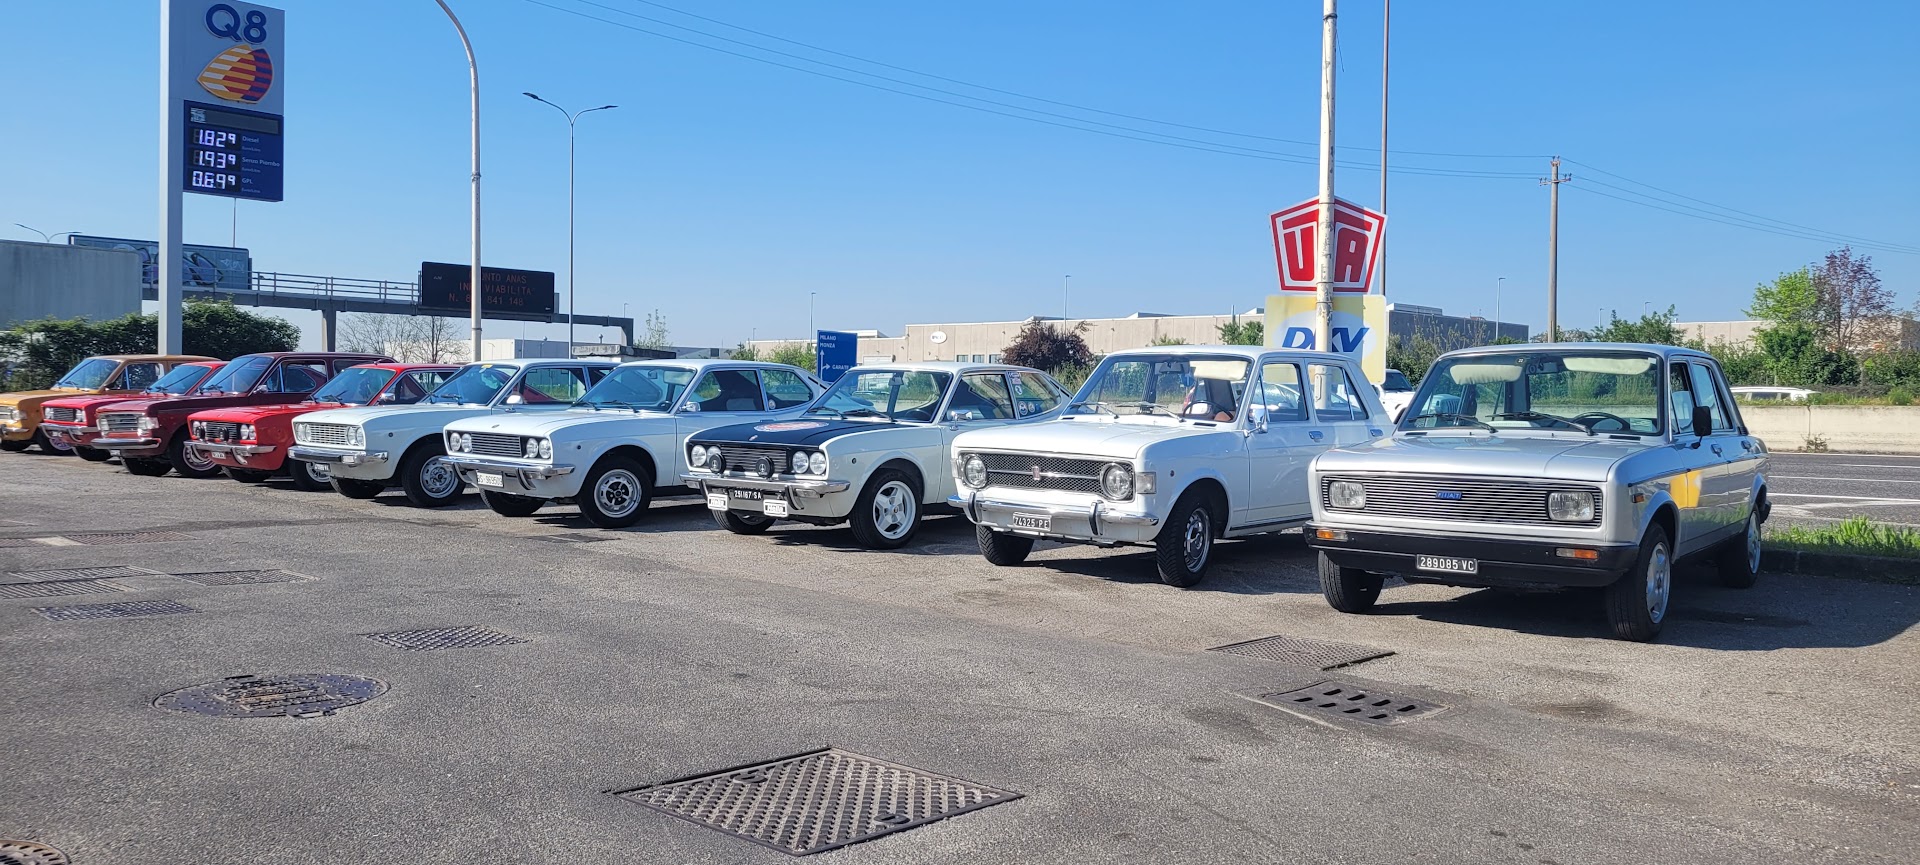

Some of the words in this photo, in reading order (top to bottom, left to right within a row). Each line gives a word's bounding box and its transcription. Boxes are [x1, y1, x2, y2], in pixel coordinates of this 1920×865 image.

[205, 3, 267, 44] Q8
[506, 274, 527, 284] ANAS
[1282, 327, 1370, 353] DV
[753, 491, 762, 499] SA
[1015, 517, 1036, 528] 74325
[1038, 519, 1049, 529] PE
[1420, 557, 1459, 570] 289085
[1461, 560, 1474, 571] VC
